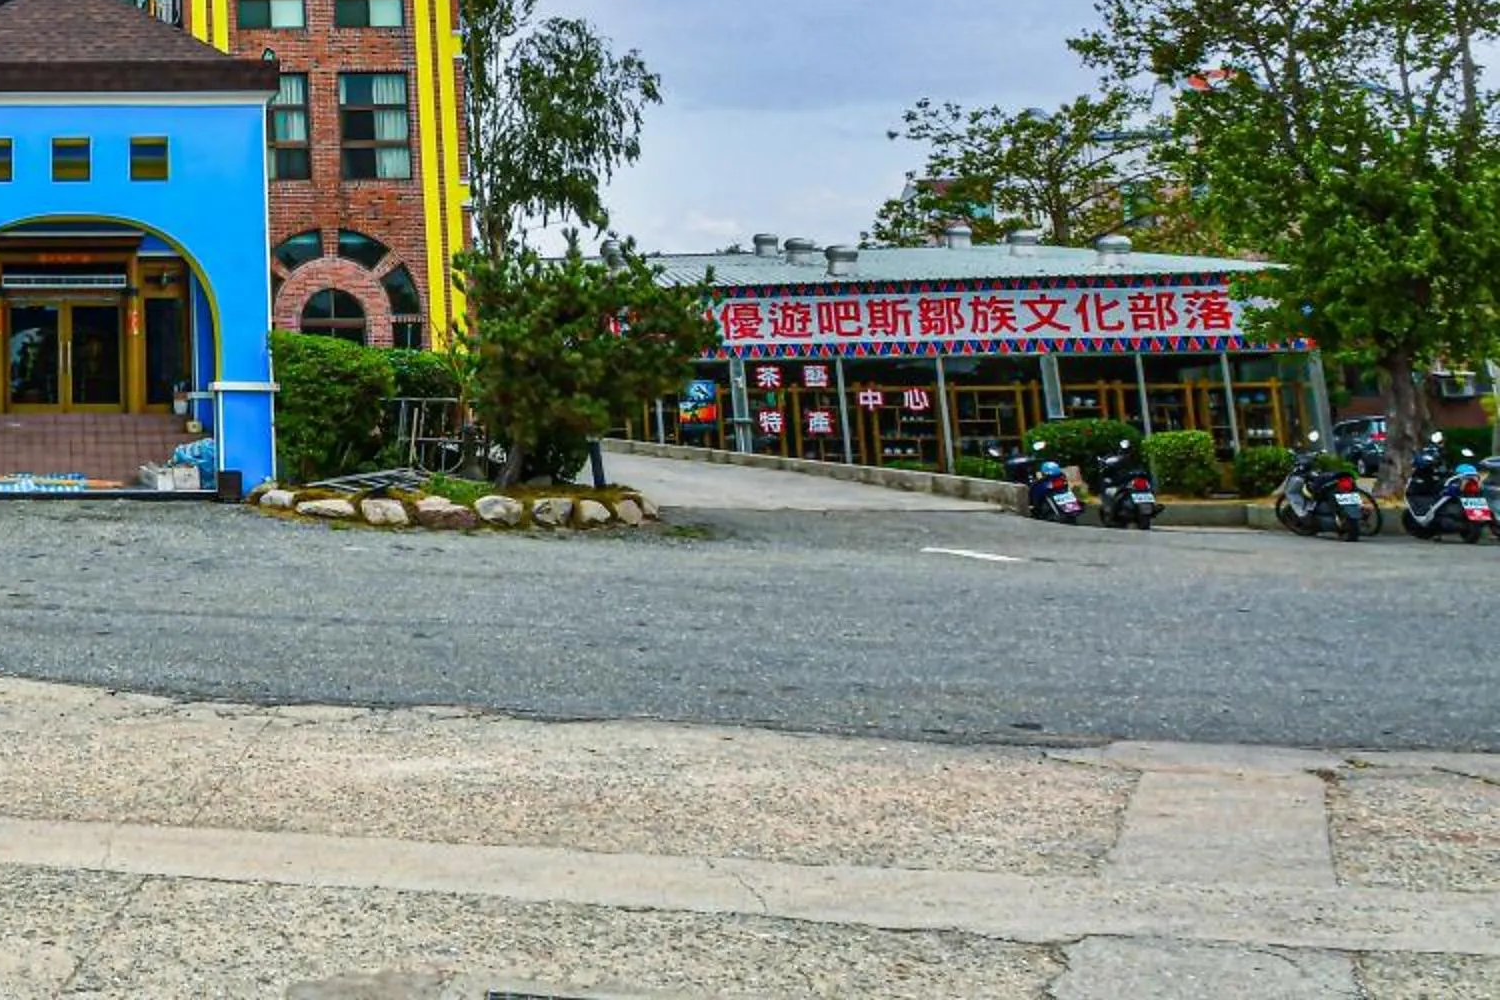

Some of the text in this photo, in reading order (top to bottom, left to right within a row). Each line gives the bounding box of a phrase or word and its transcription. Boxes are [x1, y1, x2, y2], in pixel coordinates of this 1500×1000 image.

[719, 290, 1232, 340] 優遊吧斯鄒族文化部落
[859, 388, 929, 411] 中心
[759, 411, 831, 433] 特產
